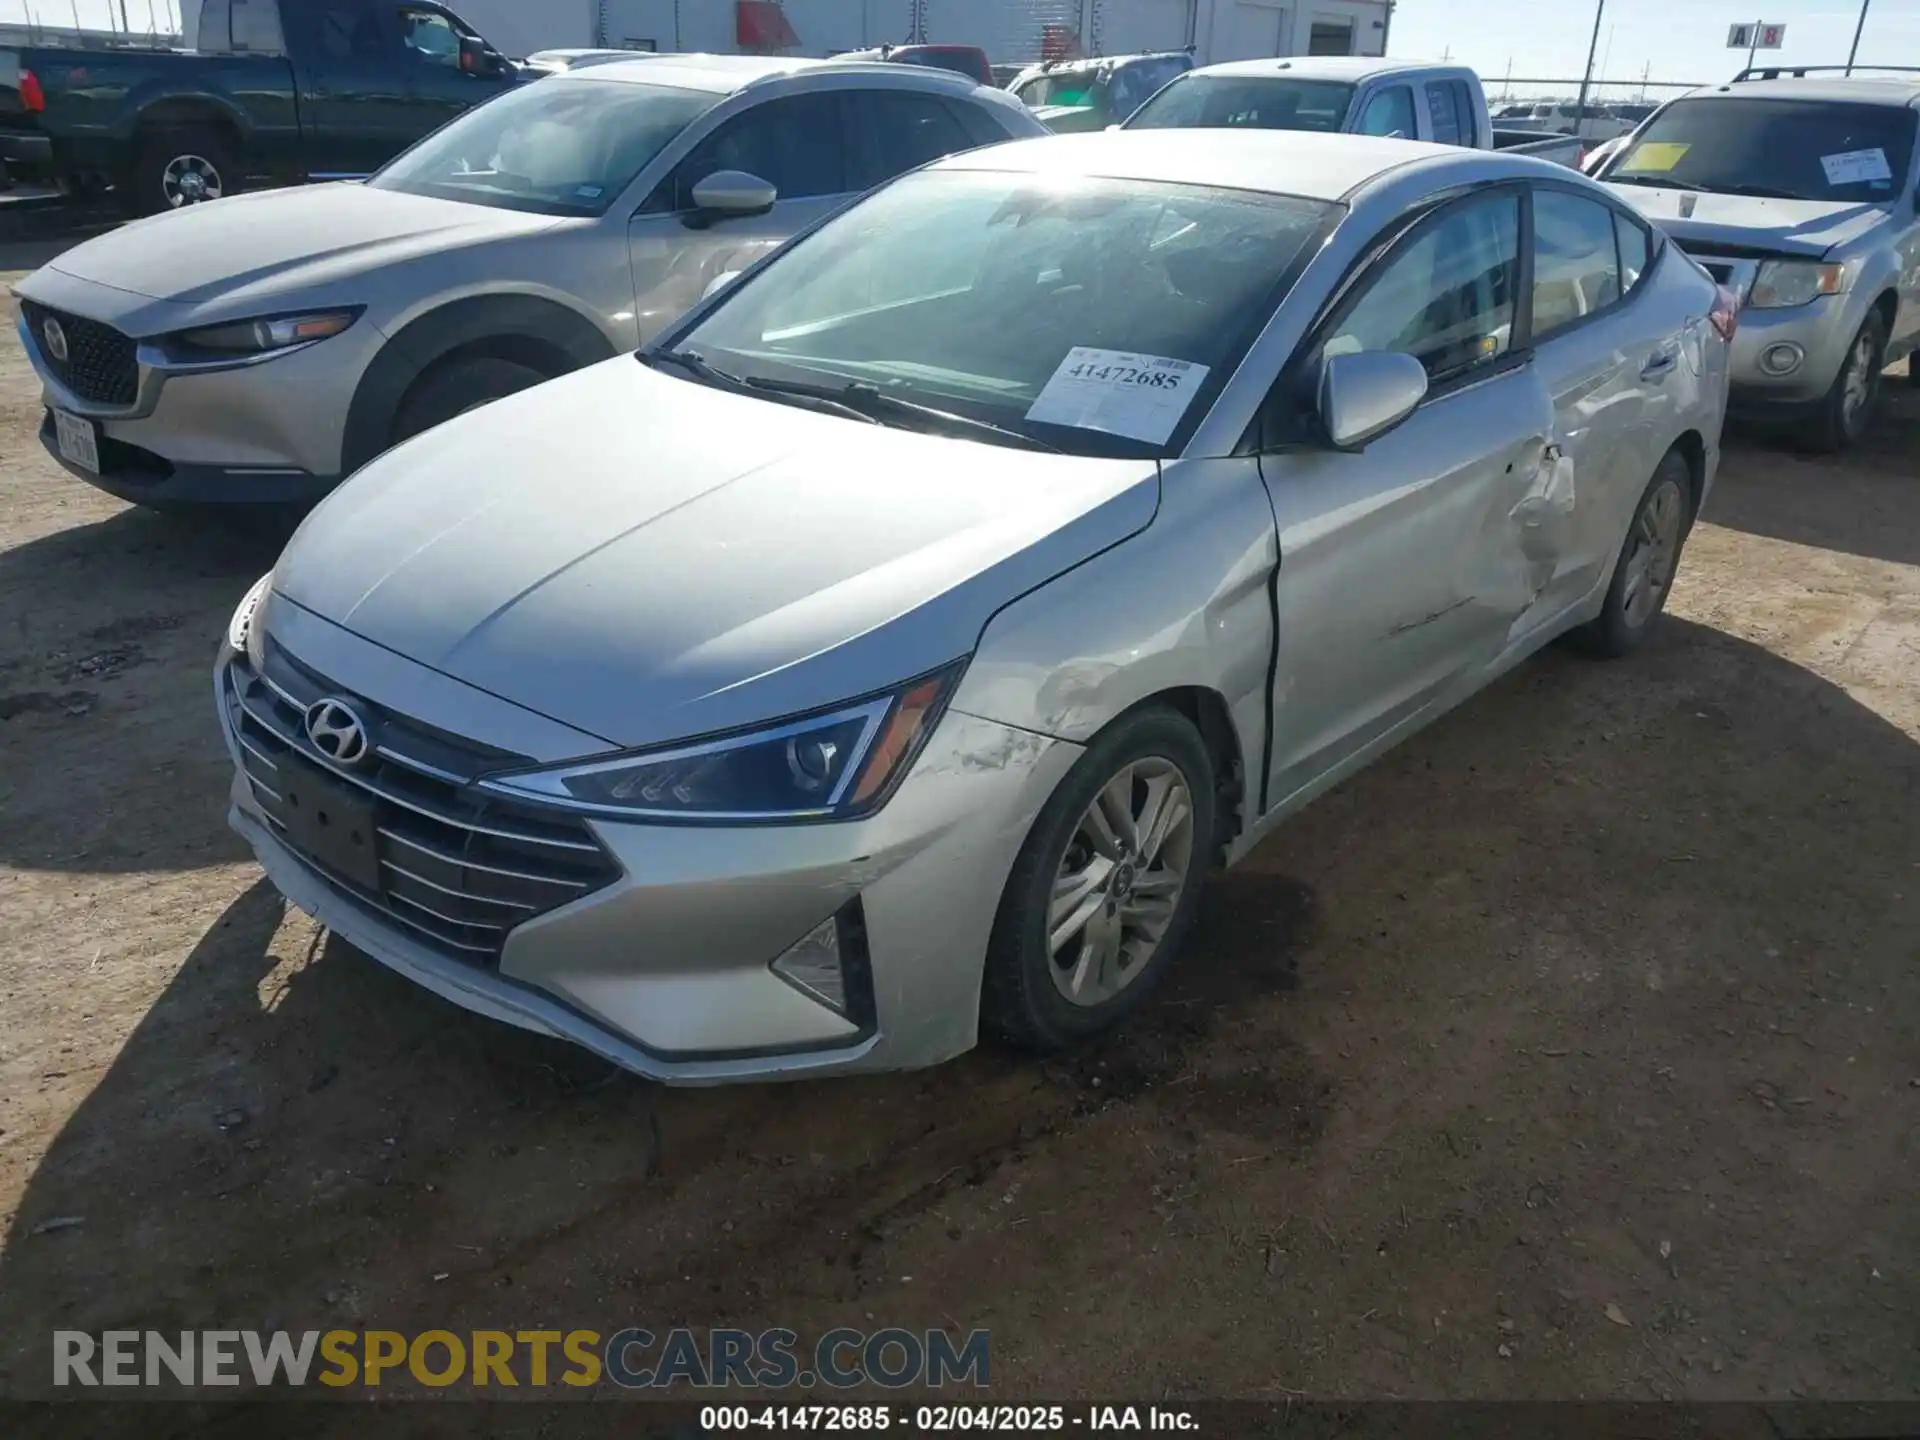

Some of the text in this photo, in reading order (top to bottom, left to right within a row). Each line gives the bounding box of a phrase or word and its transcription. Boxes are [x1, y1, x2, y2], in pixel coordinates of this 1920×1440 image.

[1732, 27, 1779, 45] A 8
[1067, 362, 1183, 390] 41472685
